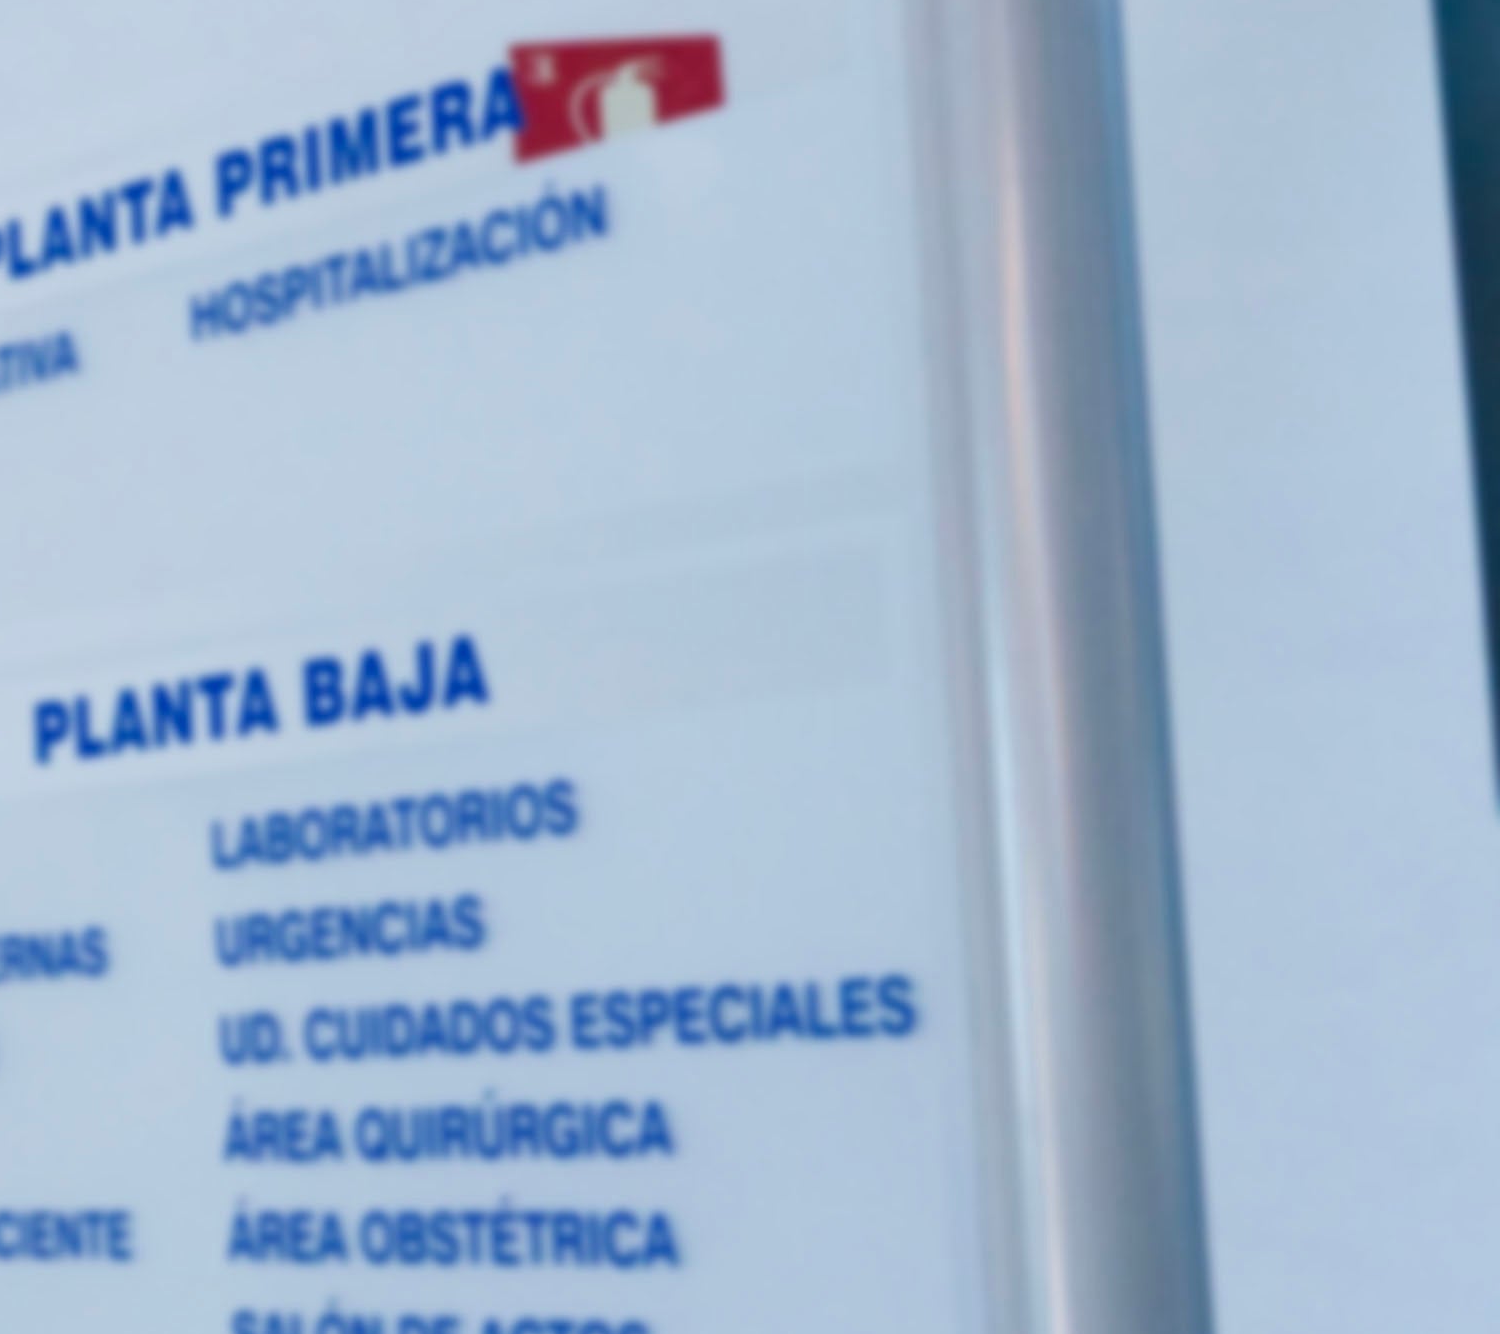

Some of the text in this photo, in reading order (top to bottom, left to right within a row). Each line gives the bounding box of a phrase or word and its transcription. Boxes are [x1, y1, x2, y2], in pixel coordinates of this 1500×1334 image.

[215, 65, 528, 221] PRIMERA
[190, 179, 609, 343] HOSPITALIZACIÓN
[33, 634, 490, 765] PLANTA BAJA
[211, 777, 579, 870] LABORATORIOS
[216, 893, 486, 966] URGENCIAS
[220, 974, 917, 1066] UD. CUIDADOS ESPECIALES
[224, 1086, 674, 1162] ÁREA QUIRÚRGICA
[228, 1193, 681, 1267] ÁREA OBSTÉTRICA
